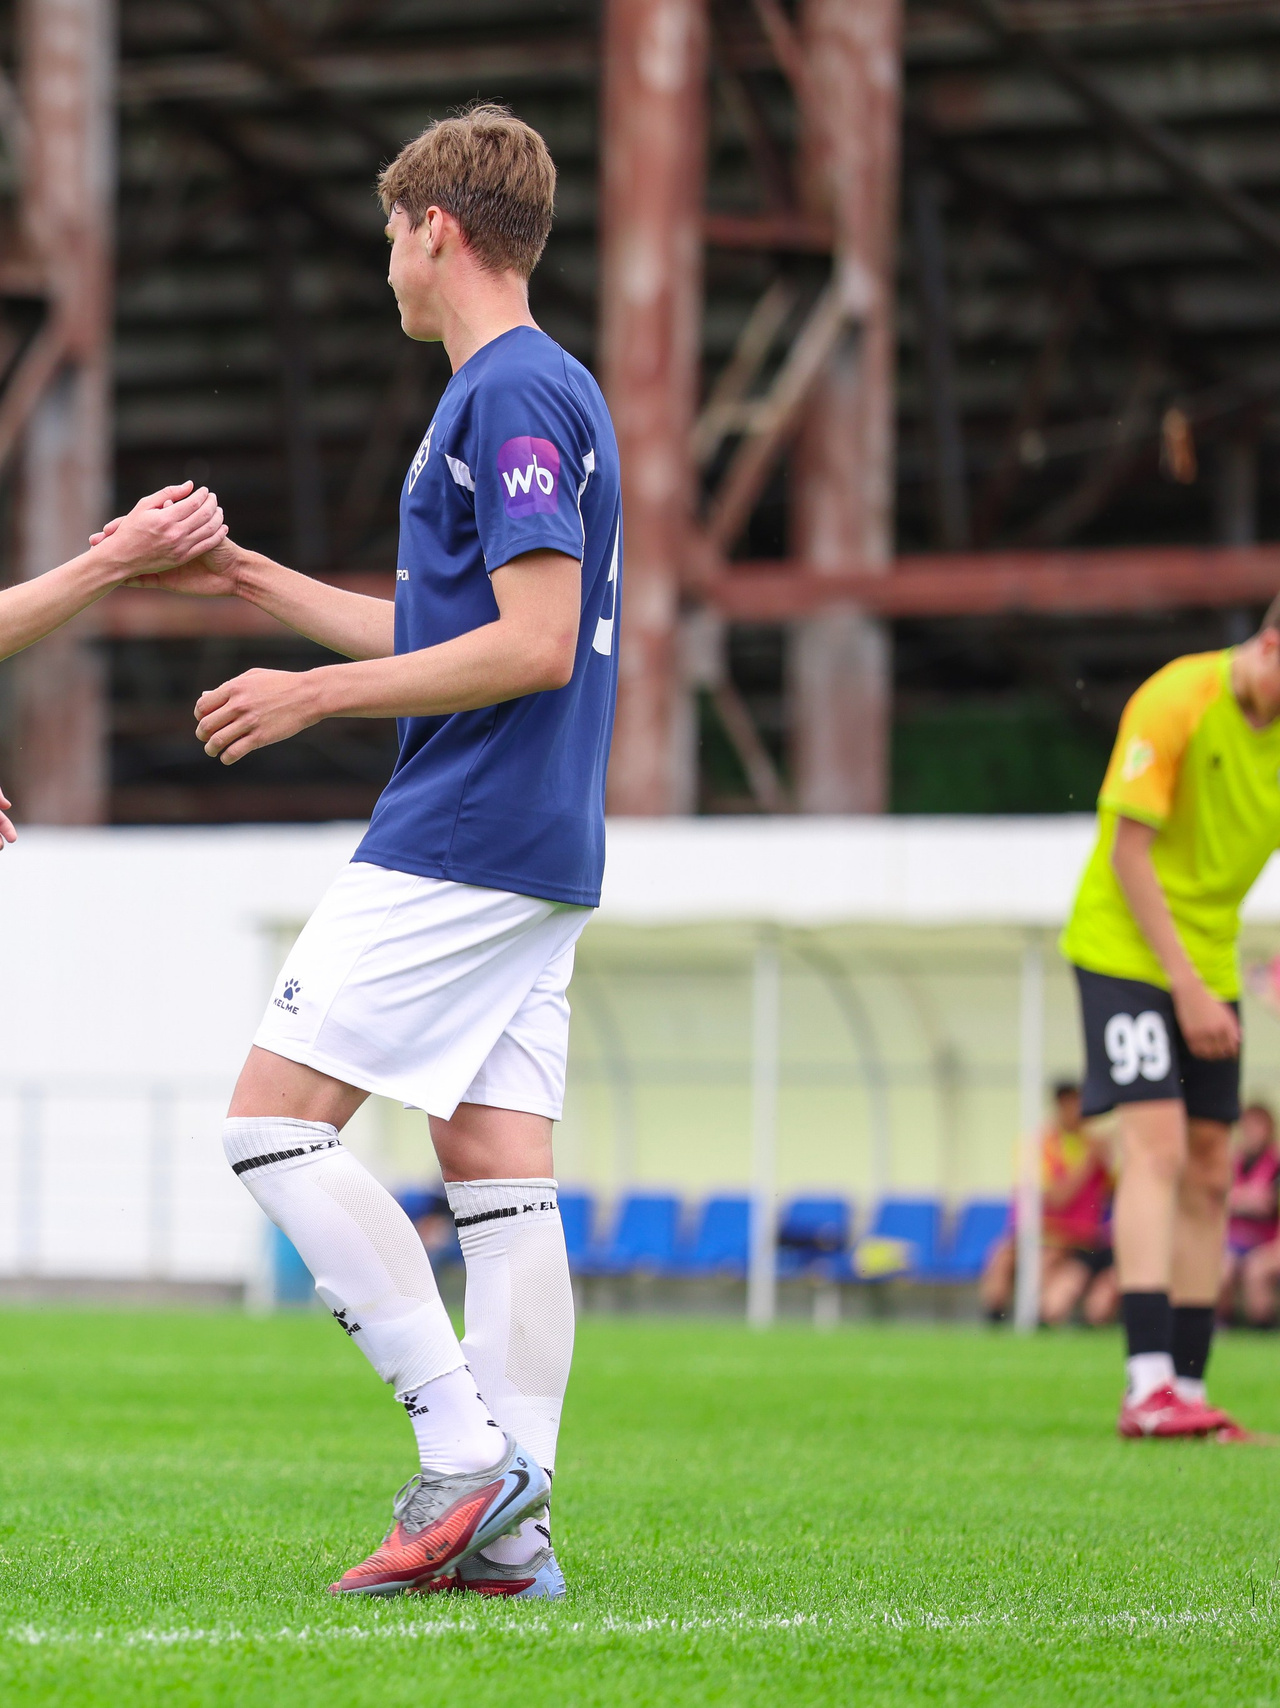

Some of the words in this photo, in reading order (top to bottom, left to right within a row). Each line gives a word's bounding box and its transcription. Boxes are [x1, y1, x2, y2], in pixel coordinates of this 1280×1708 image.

[502, 454, 554, 497] wb
[273, 997, 300, 1015] KELME
[1104, 1010, 1172, 1086] 99
